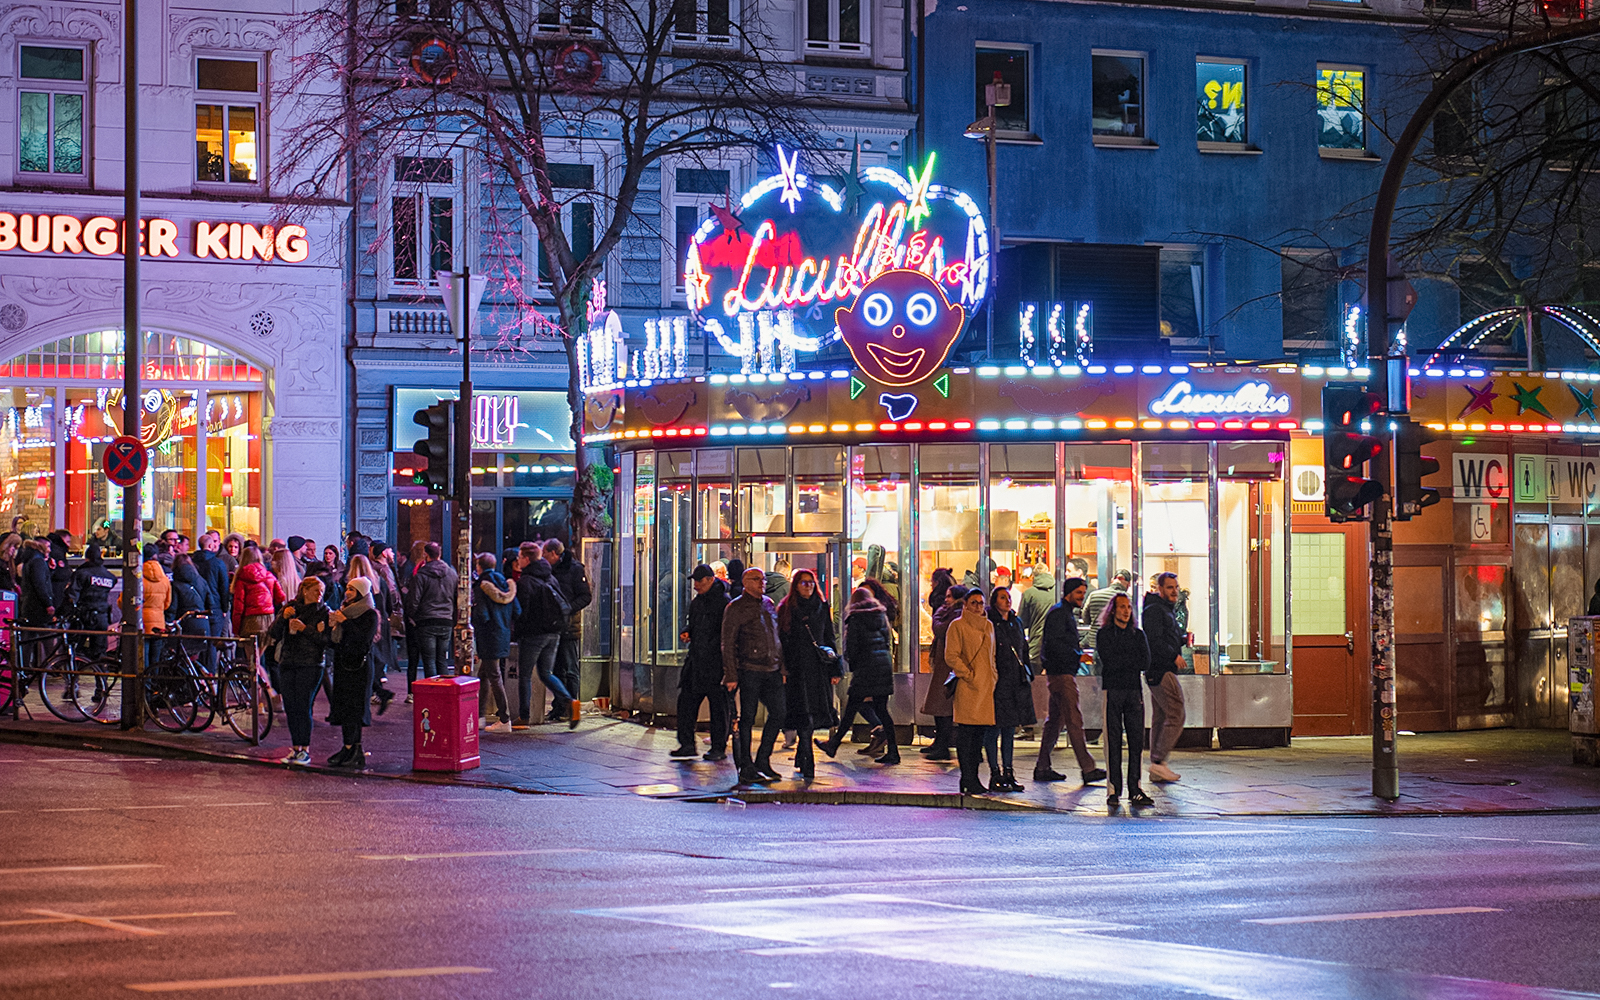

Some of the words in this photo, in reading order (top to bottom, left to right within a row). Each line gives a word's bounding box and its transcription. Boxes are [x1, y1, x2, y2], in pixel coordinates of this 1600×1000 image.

[196, 220, 309, 263] KING
[1150, 380, 1291, 415] Lucullus
[1458, 459, 1503, 498] WC
[1567, 461, 1596, 499] WC
